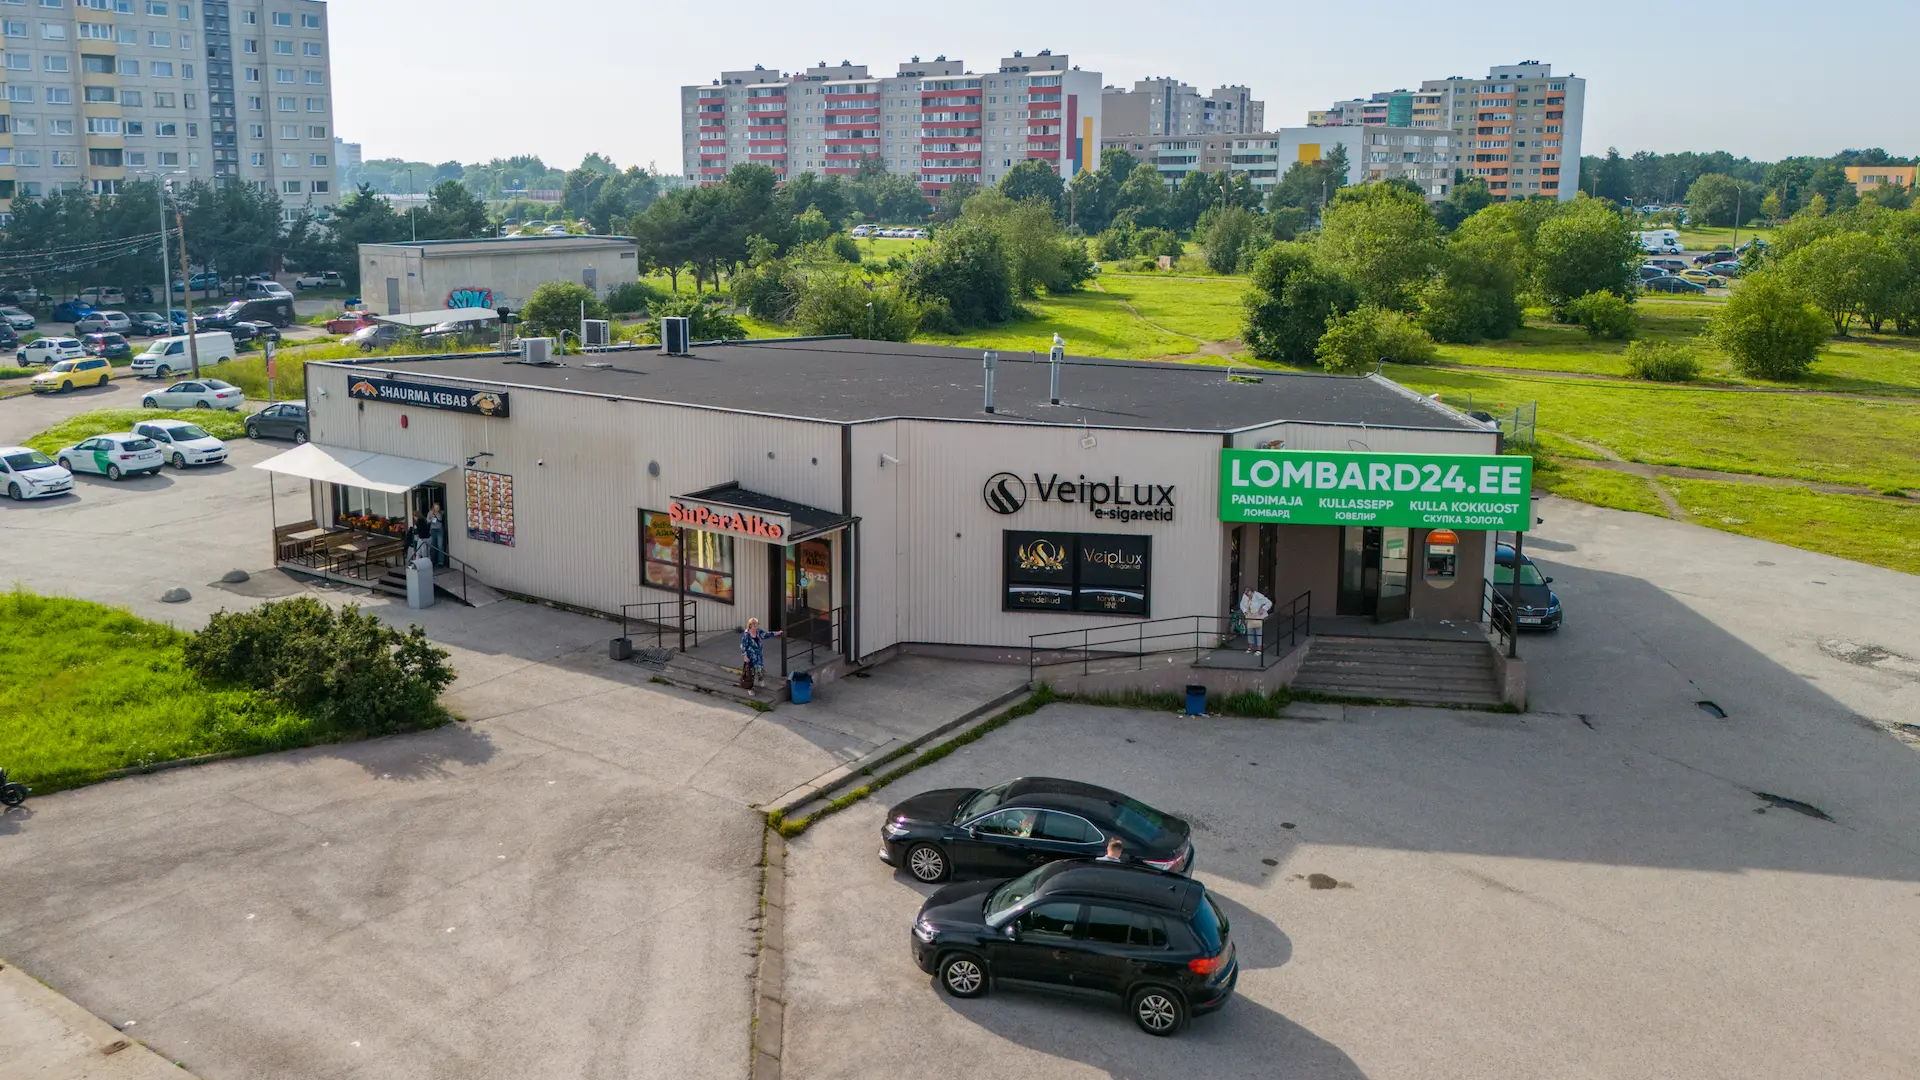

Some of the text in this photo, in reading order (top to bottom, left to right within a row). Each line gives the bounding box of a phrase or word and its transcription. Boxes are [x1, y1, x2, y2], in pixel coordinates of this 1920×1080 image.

[380, 385, 430, 402] SHAURMA
[433, 391, 468, 407] KEBAB
[1231, 458, 1523, 495] LOMBARD24.EE
[1033, 473, 1175, 512] VeipLux
[1231, 493, 1304, 507] PANDIMAJA
[1319, 497, 1395, 510] KULLASSEPP
[1409, 500, 1520, 514] KULLA KOKKUOST
[1094, 507, 1174, 523] e-sigaretid
[1243, 508, 1291, 519] ЛОМБАРД
[1335, 511, 1377, 521] ЮВЕЛИР
[1423, 514, 1504, 525] СКУПКА ЗОЛОТА
[1084, 547, 1143, 566] VeipLux
[804, 571, 828, 582] 10-22
